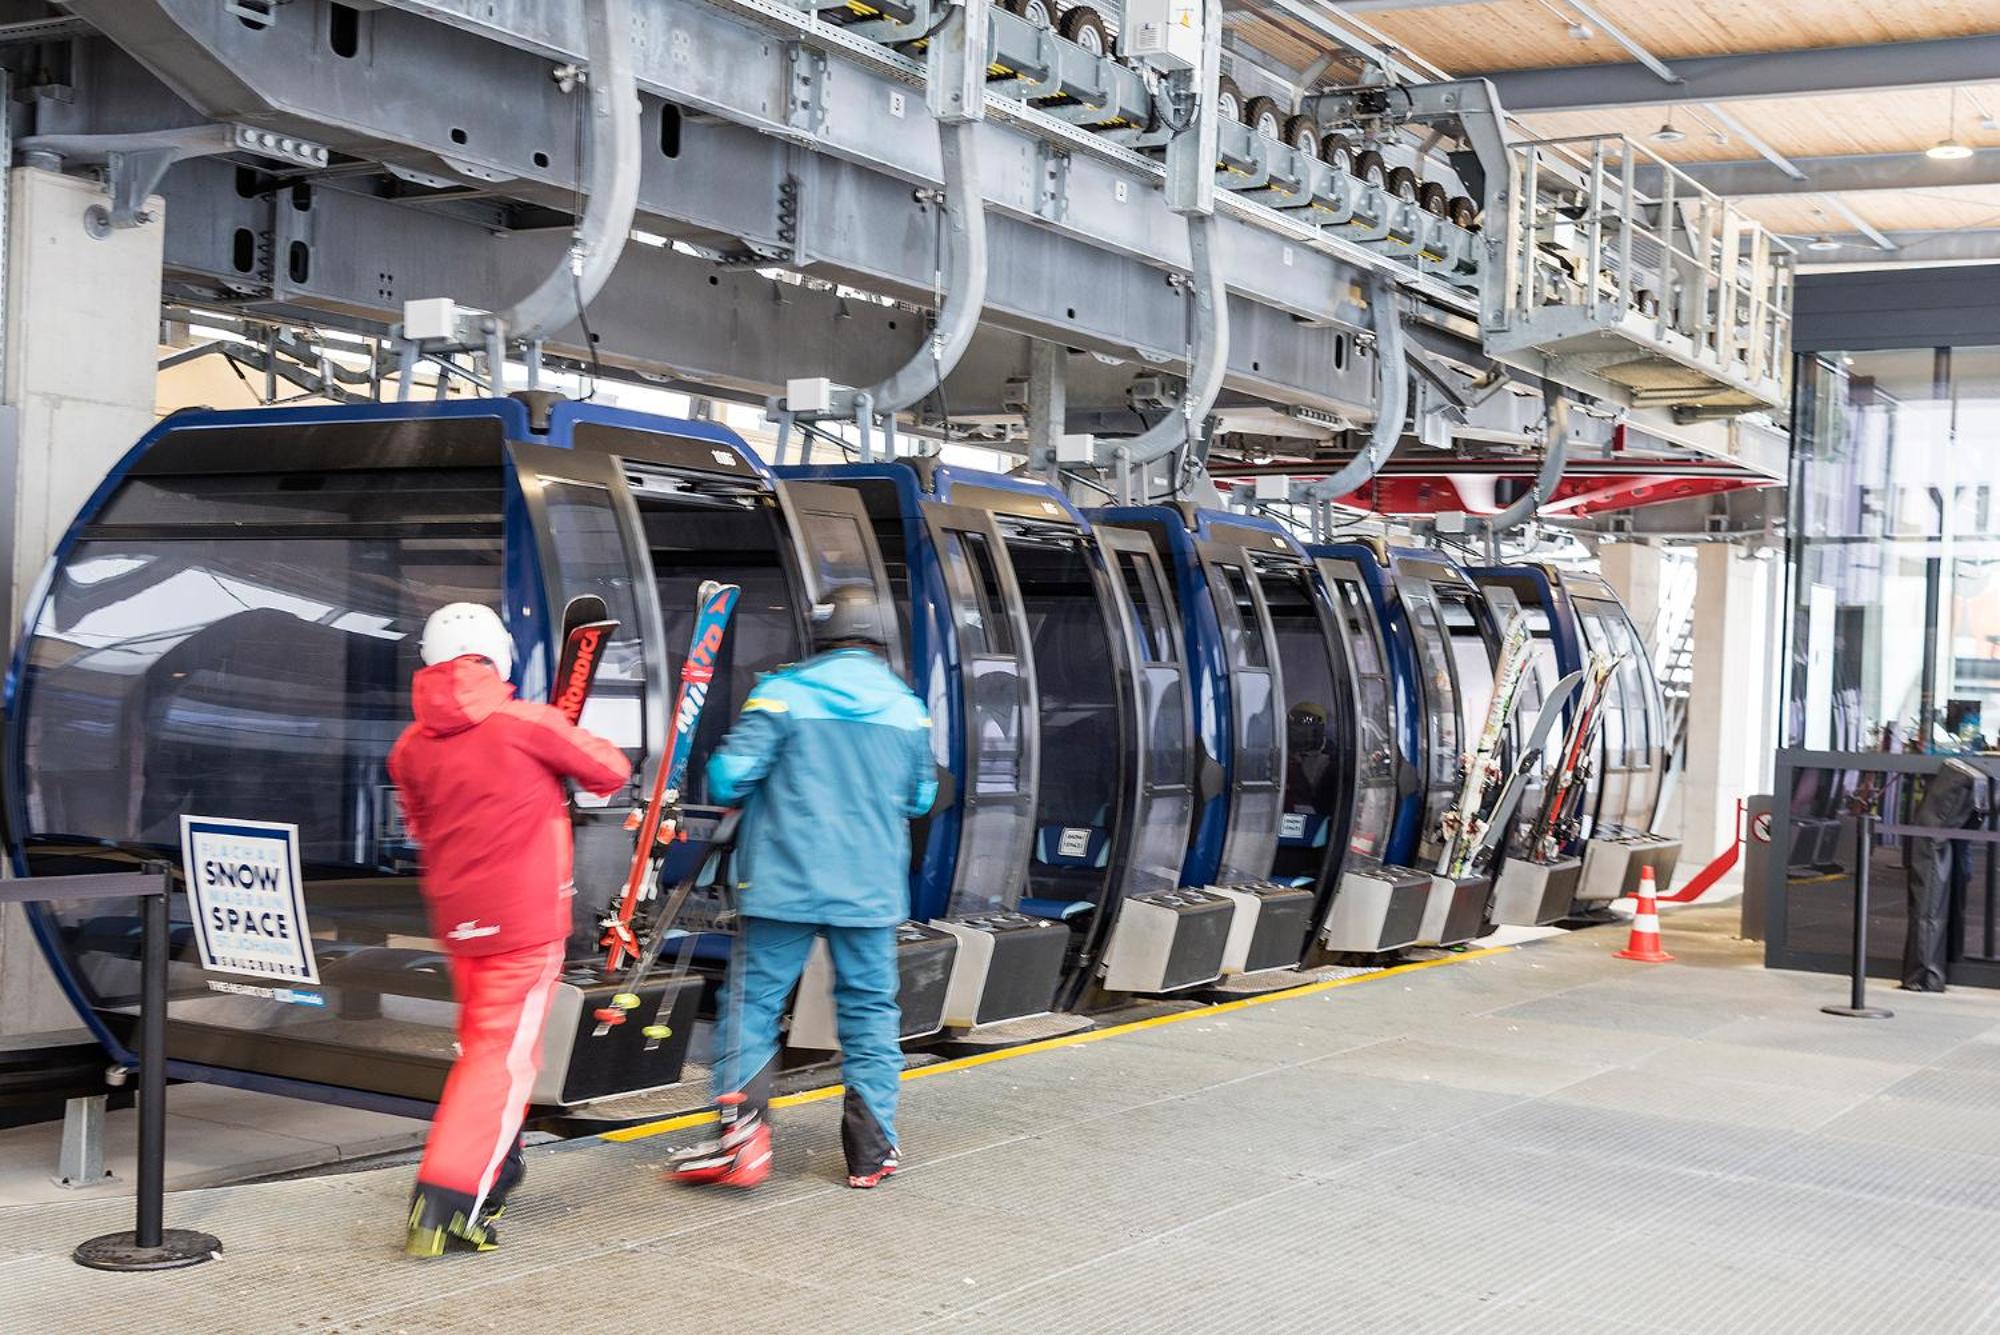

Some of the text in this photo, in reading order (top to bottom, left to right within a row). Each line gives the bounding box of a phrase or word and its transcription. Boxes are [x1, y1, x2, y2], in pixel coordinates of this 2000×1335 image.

[557, 629, 601, 724] NORDICA
[205, 860, 280, 893] SNOW
[212, 906, 289, 938] SPACE
